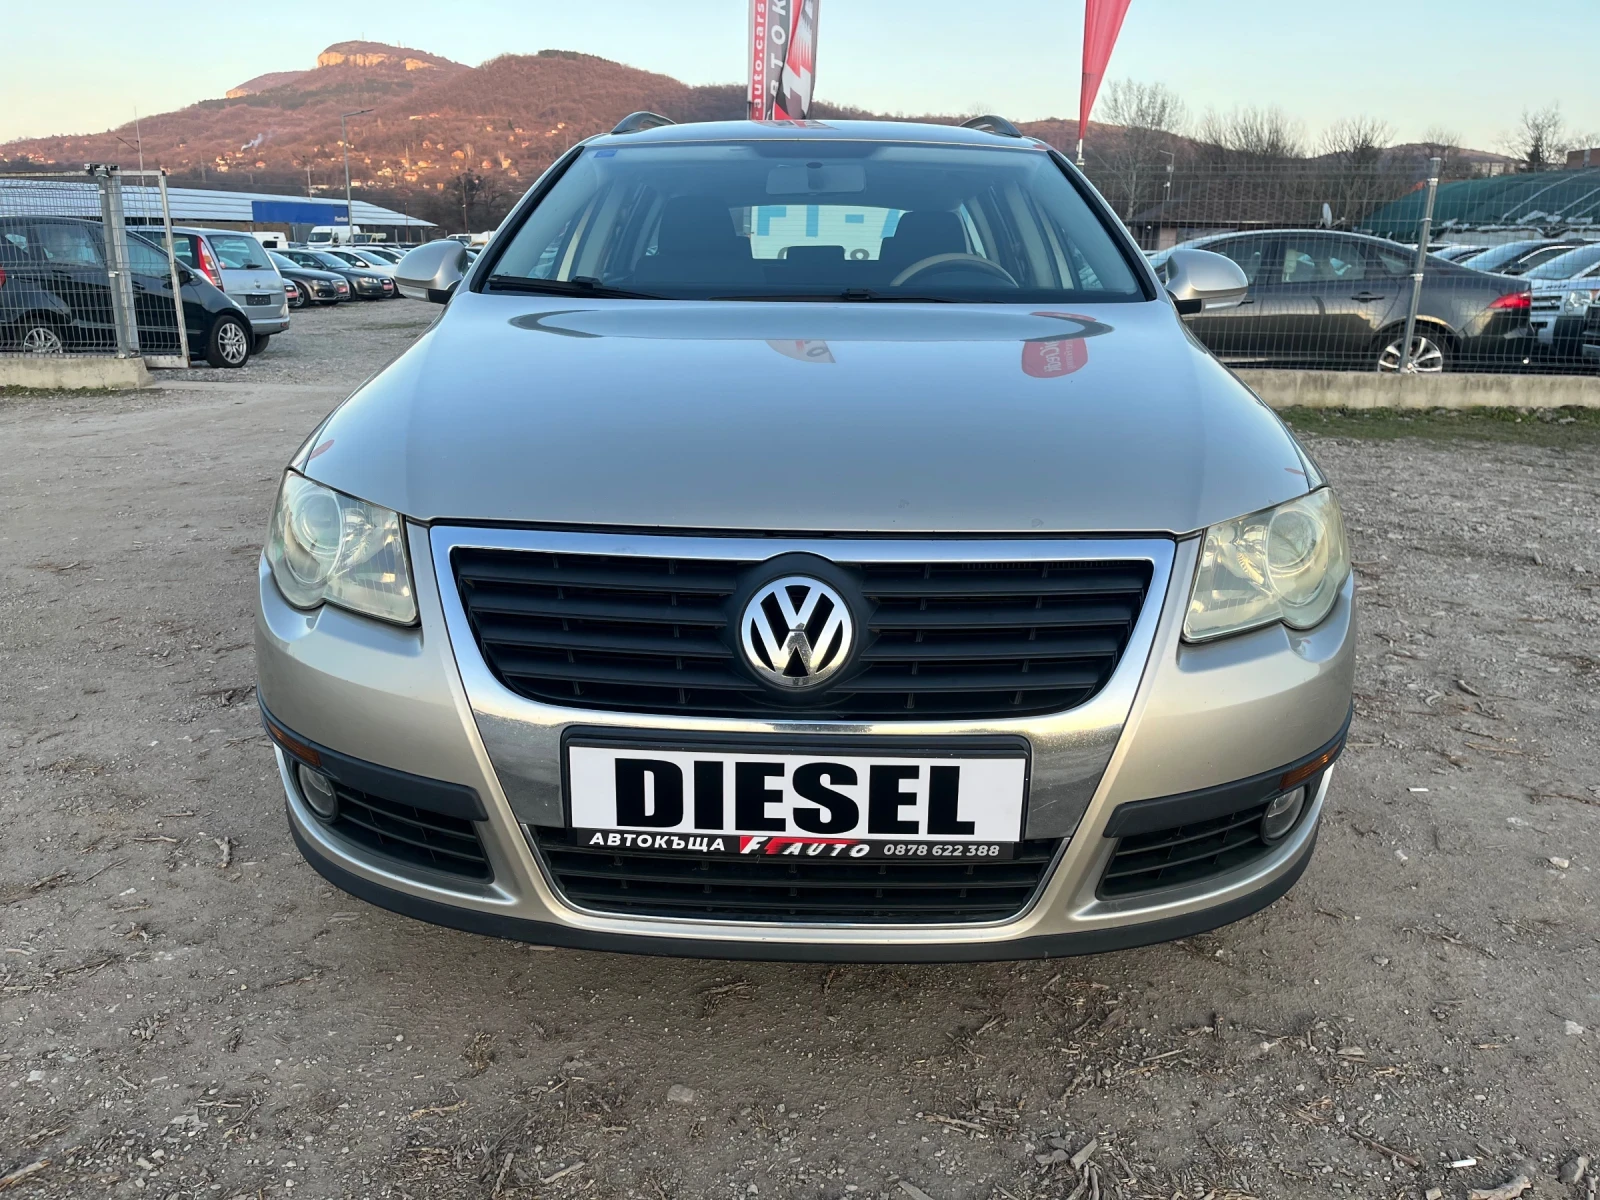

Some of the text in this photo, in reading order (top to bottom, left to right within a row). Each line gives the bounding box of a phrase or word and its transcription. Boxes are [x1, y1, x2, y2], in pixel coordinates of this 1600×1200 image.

[615, 757, 976, 835] DIESEL
[588, 832, 726, 852] АВТОКЪЩА
[883, 844, 928, 856] 0878
[931, 845, 963, 856] 622
[966, 845, 1000, 856] 388
